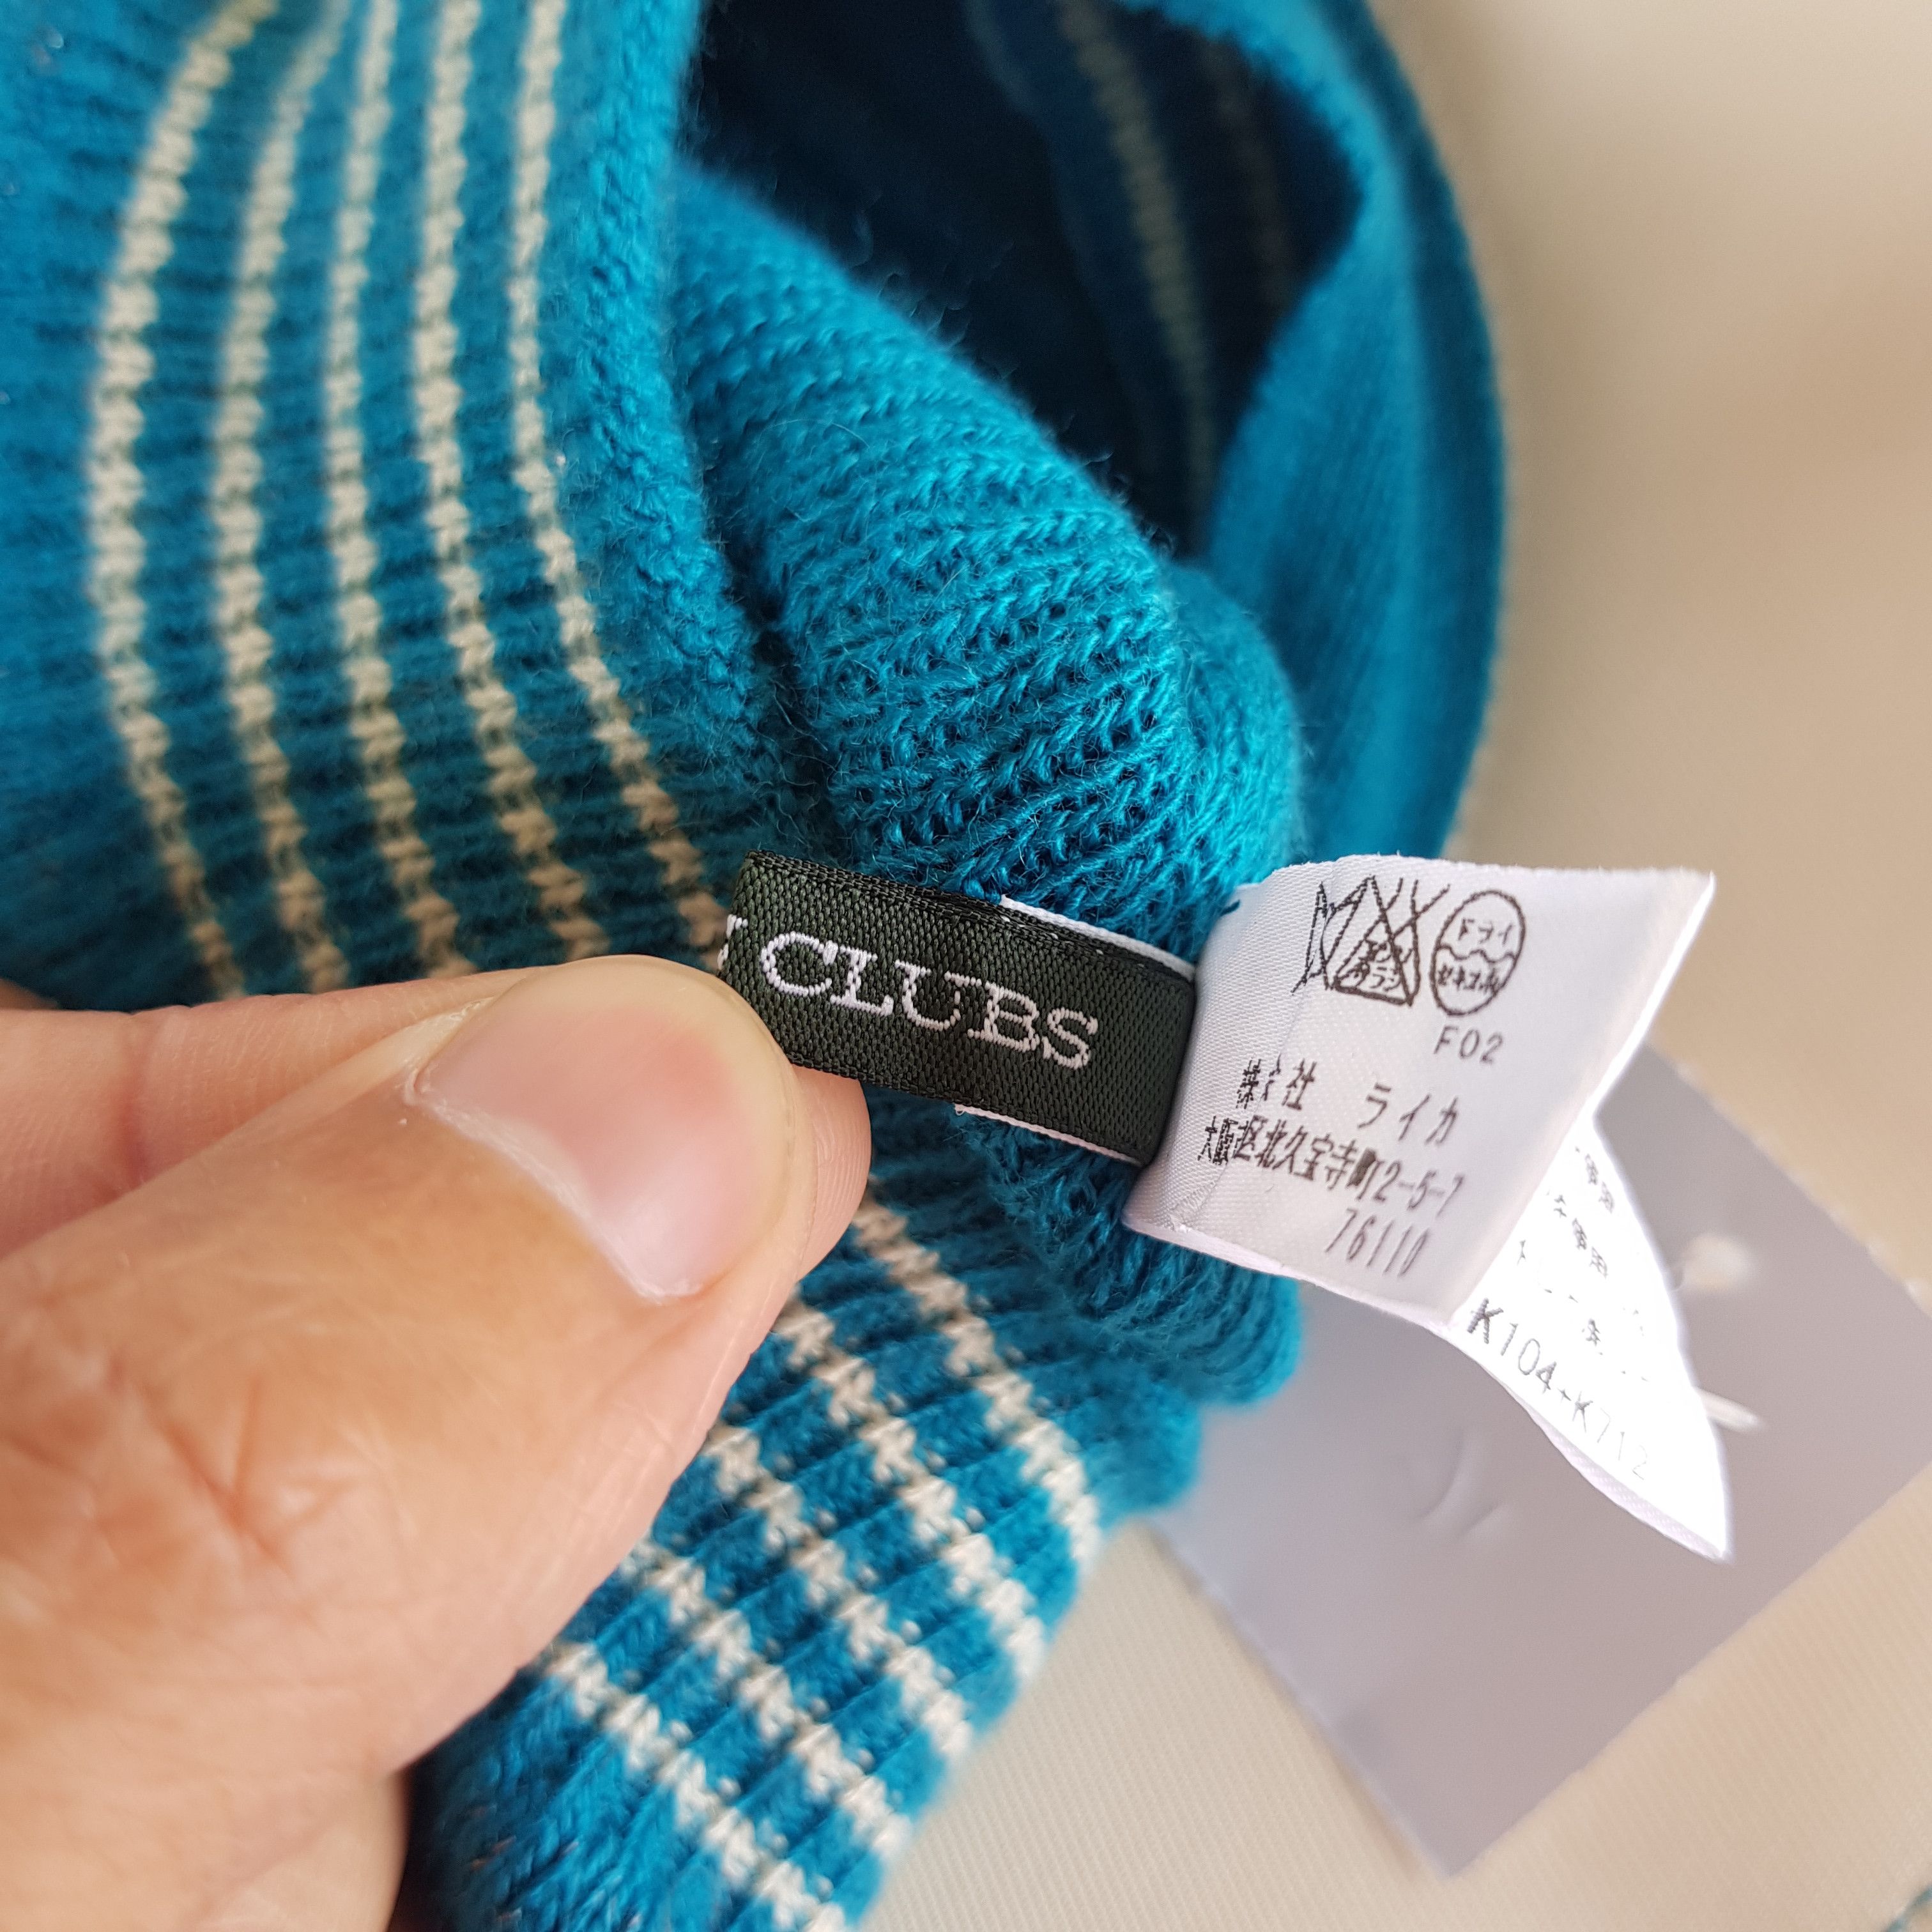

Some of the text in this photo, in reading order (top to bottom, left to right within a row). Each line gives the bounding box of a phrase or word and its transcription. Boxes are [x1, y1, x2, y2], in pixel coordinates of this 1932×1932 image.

[760, 931, 1099, 1071] CLUBS
[1357, 1082, 1459, 1146] ライカ
[1324, 1207, 1431, 1277] 76110
